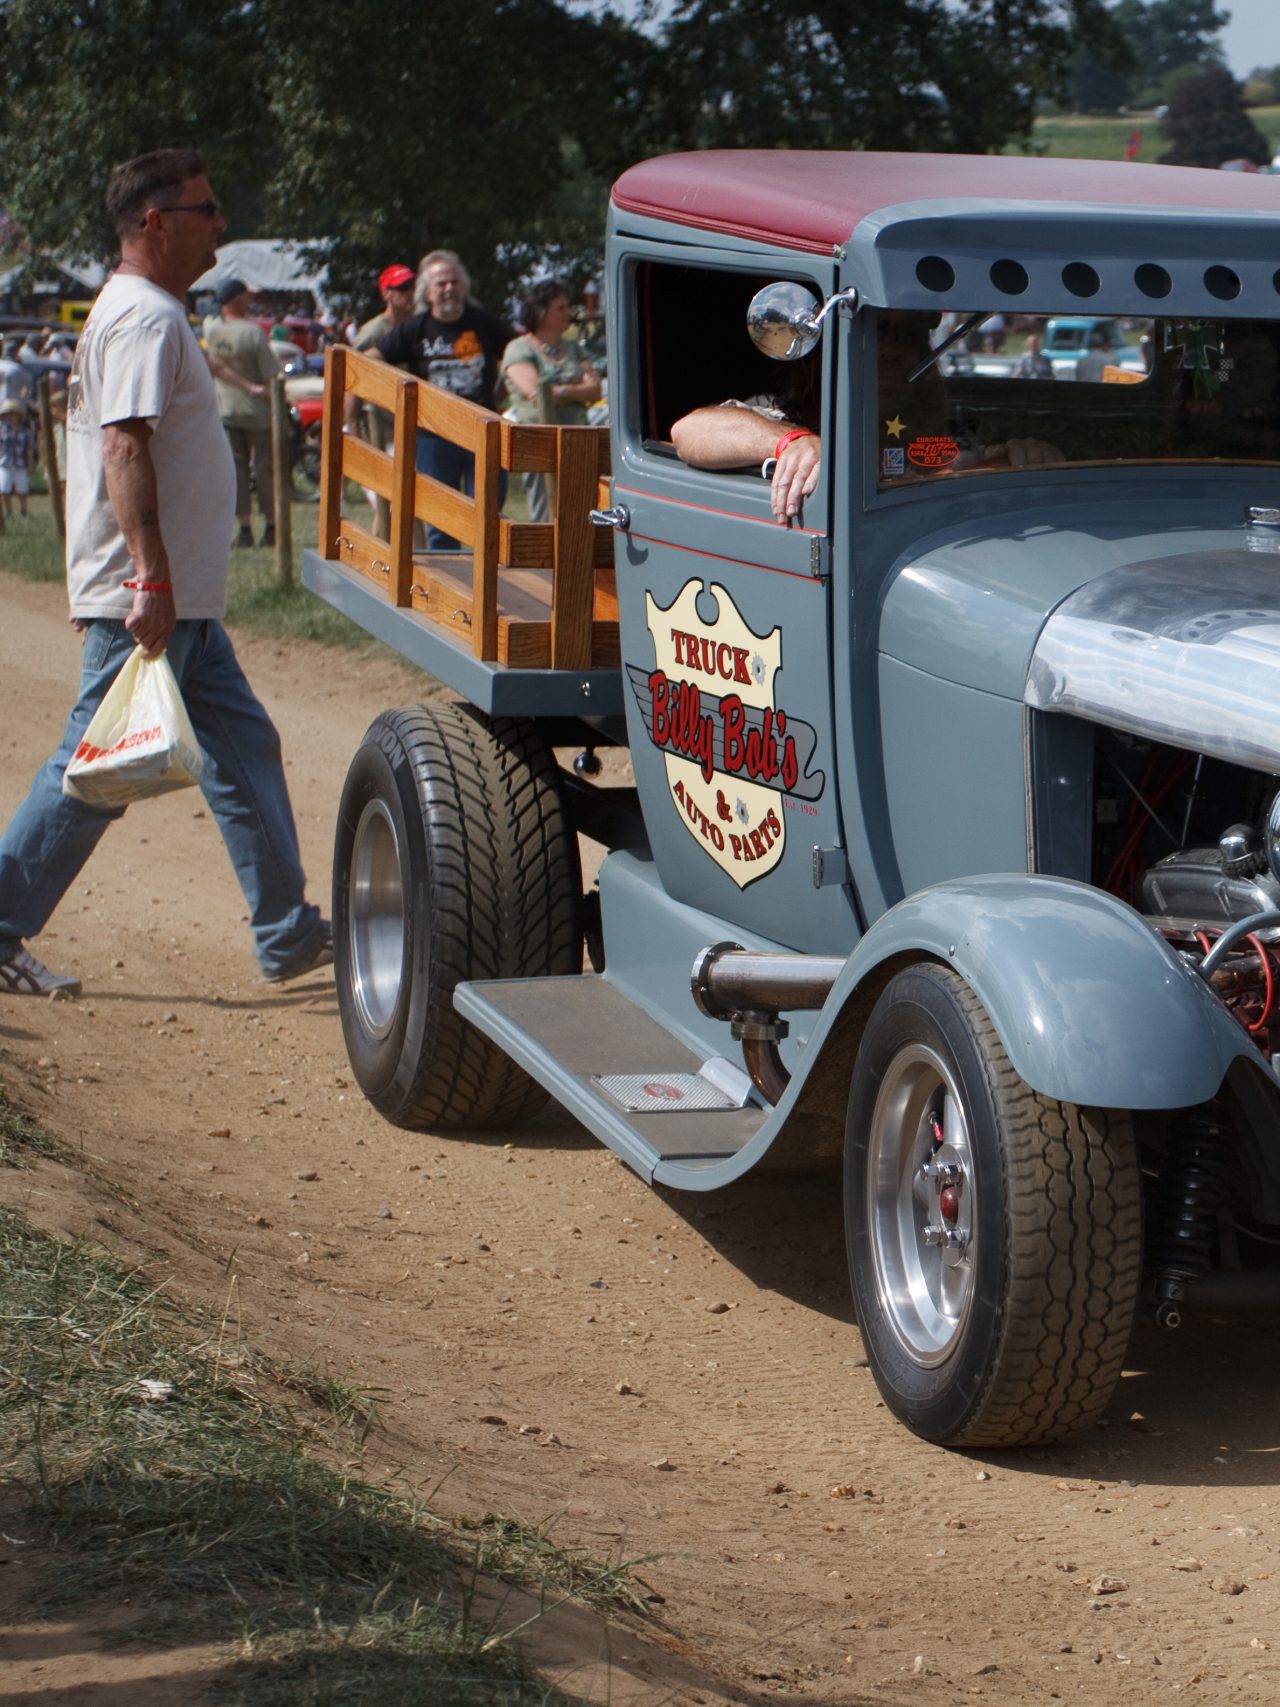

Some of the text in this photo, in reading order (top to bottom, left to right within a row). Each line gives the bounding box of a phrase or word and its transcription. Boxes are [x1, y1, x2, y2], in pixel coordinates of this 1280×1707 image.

[924, 456, 942, 465] 073
[671, 628, 752, 686] TRUCK
[647, 668, 798, 791] Billy Bob's
[673, 780, 781, 861] AUTO PARTS
[716, 789, 732, 823] &
